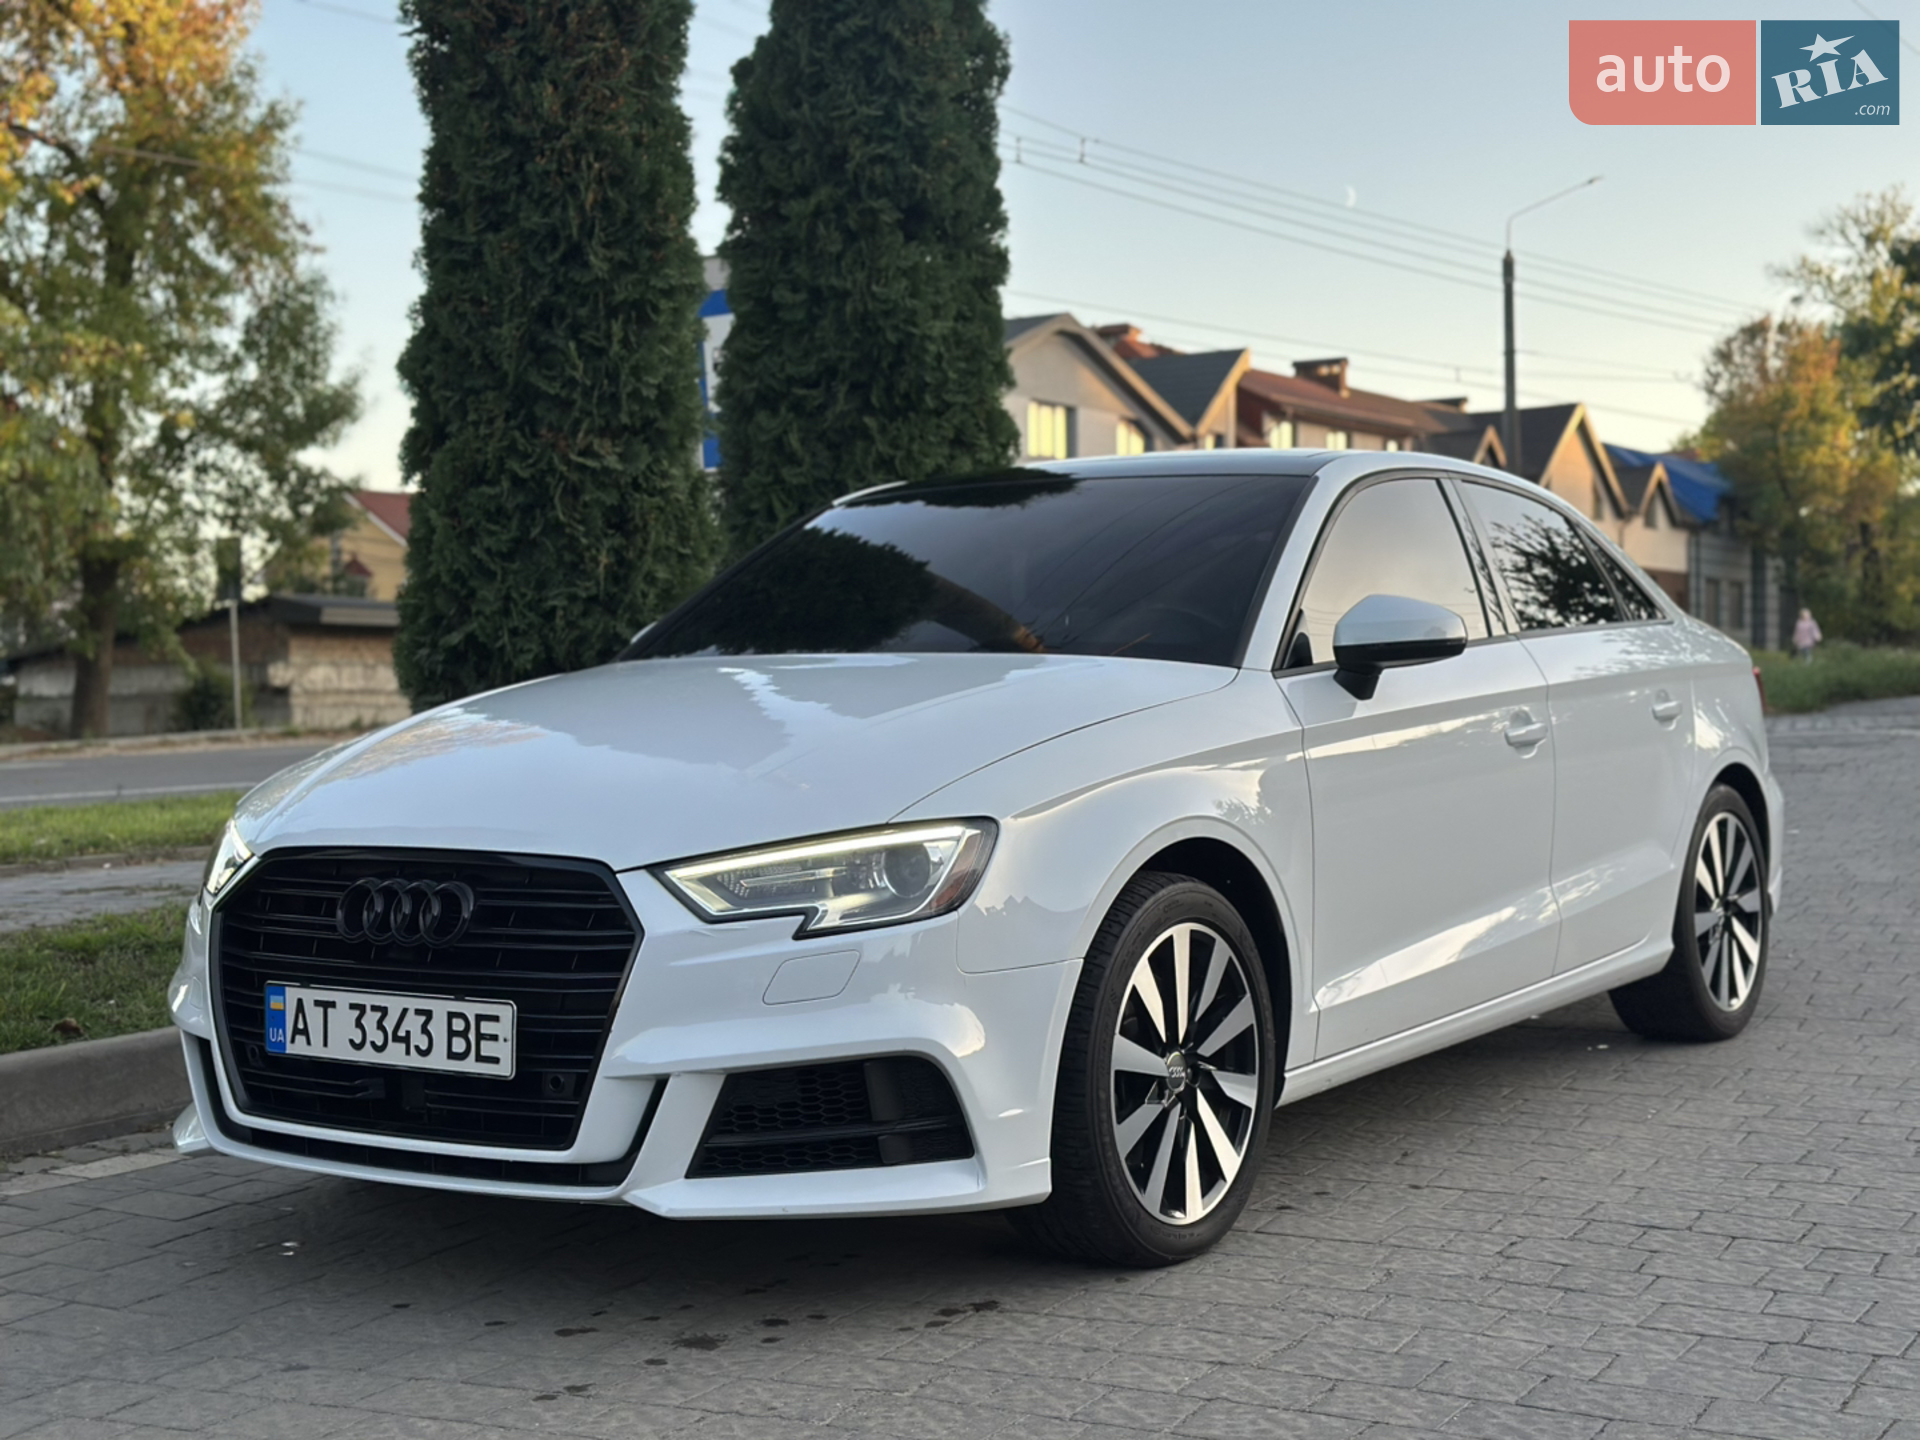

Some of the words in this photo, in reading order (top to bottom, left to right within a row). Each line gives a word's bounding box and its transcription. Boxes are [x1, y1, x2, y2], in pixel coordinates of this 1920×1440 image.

[269, 1027, 284, 1043] UA
[290, 997, 336, 1048] AT
[348, 1002, 433, 1057] 3343
[446, 1010, 500, 1064] BE
